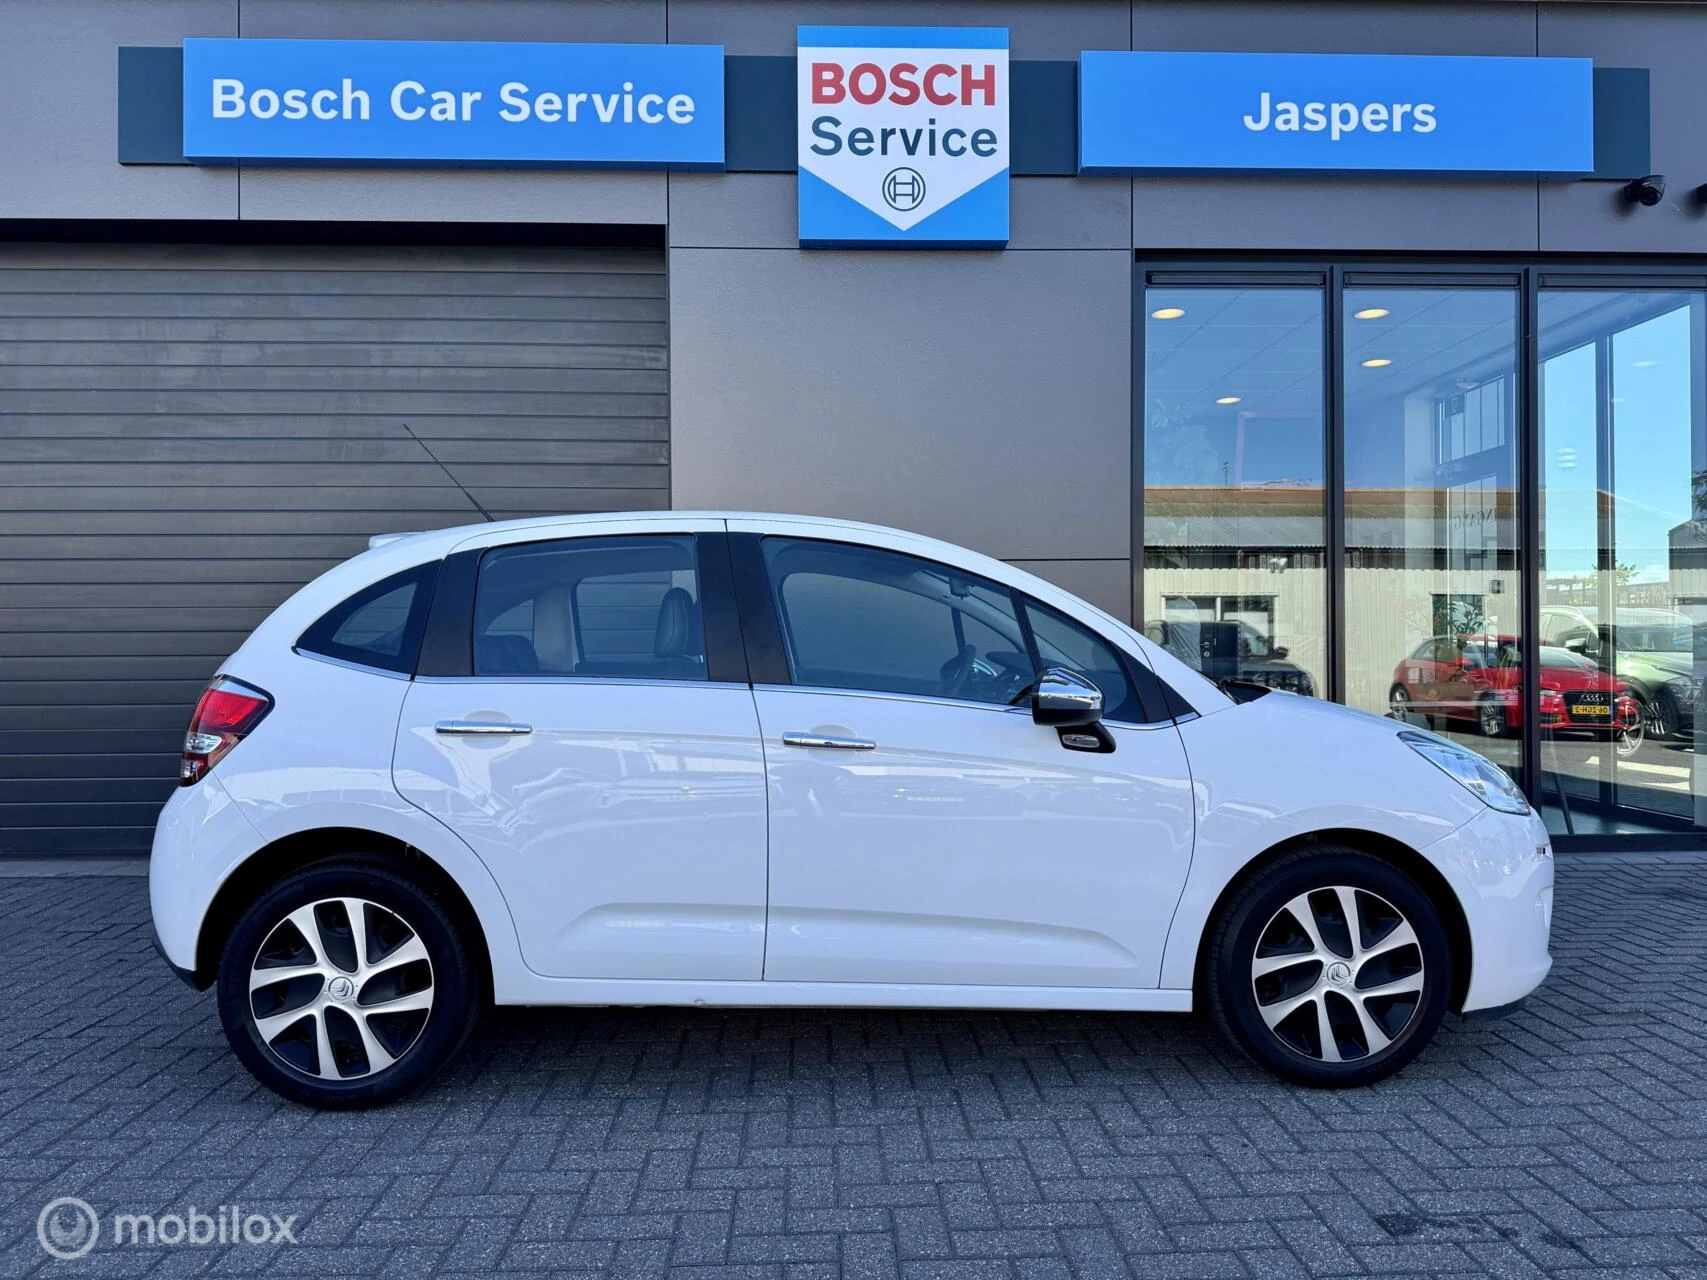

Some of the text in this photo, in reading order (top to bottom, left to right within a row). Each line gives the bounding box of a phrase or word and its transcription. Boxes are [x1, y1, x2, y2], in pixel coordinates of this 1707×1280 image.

[212, 78, 695, 124] Bosch Car Service
[811, 62, 996, 106] BOSCH
[810, 115, 998, 158] Service
[1243, 92, 1437, 141] Jaspers
